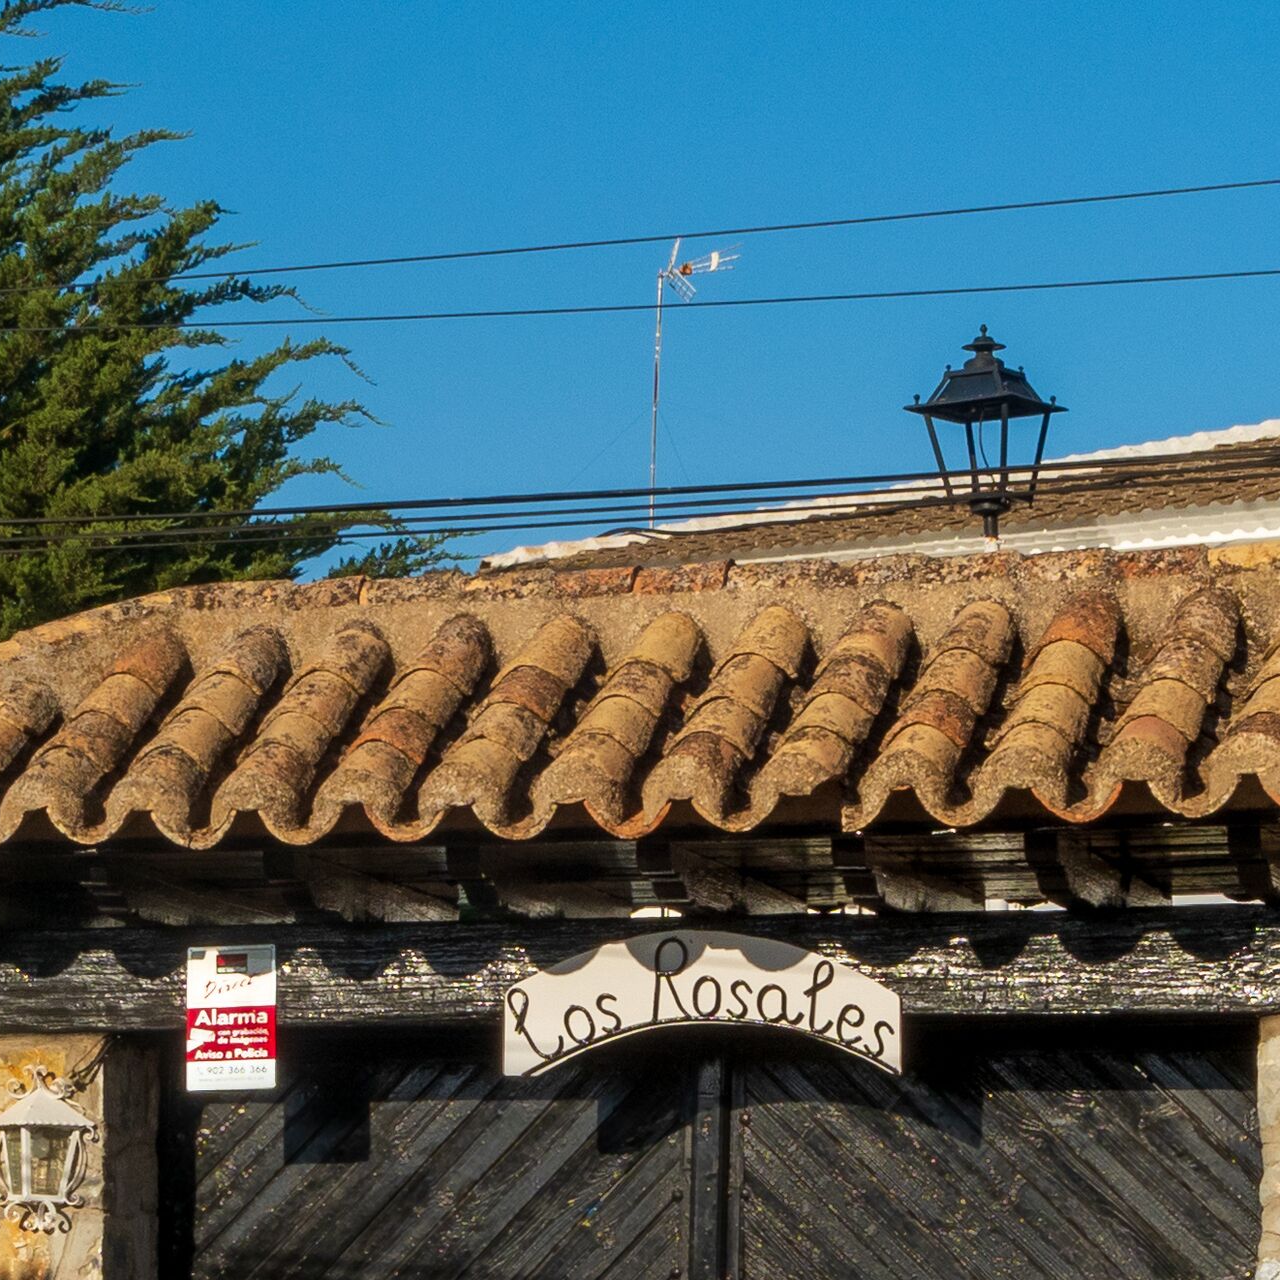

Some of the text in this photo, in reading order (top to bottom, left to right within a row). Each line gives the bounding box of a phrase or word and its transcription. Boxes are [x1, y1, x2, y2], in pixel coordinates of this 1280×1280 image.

[507, 936, 895, 1060] Los Rosales
[195, 1009, 268, 1026] Alarma
[195, 1050, 223, 1059] Aviso
[225, 1051, 233, 1059] a
[207, 1064, 267, 1075] 902 366 366
